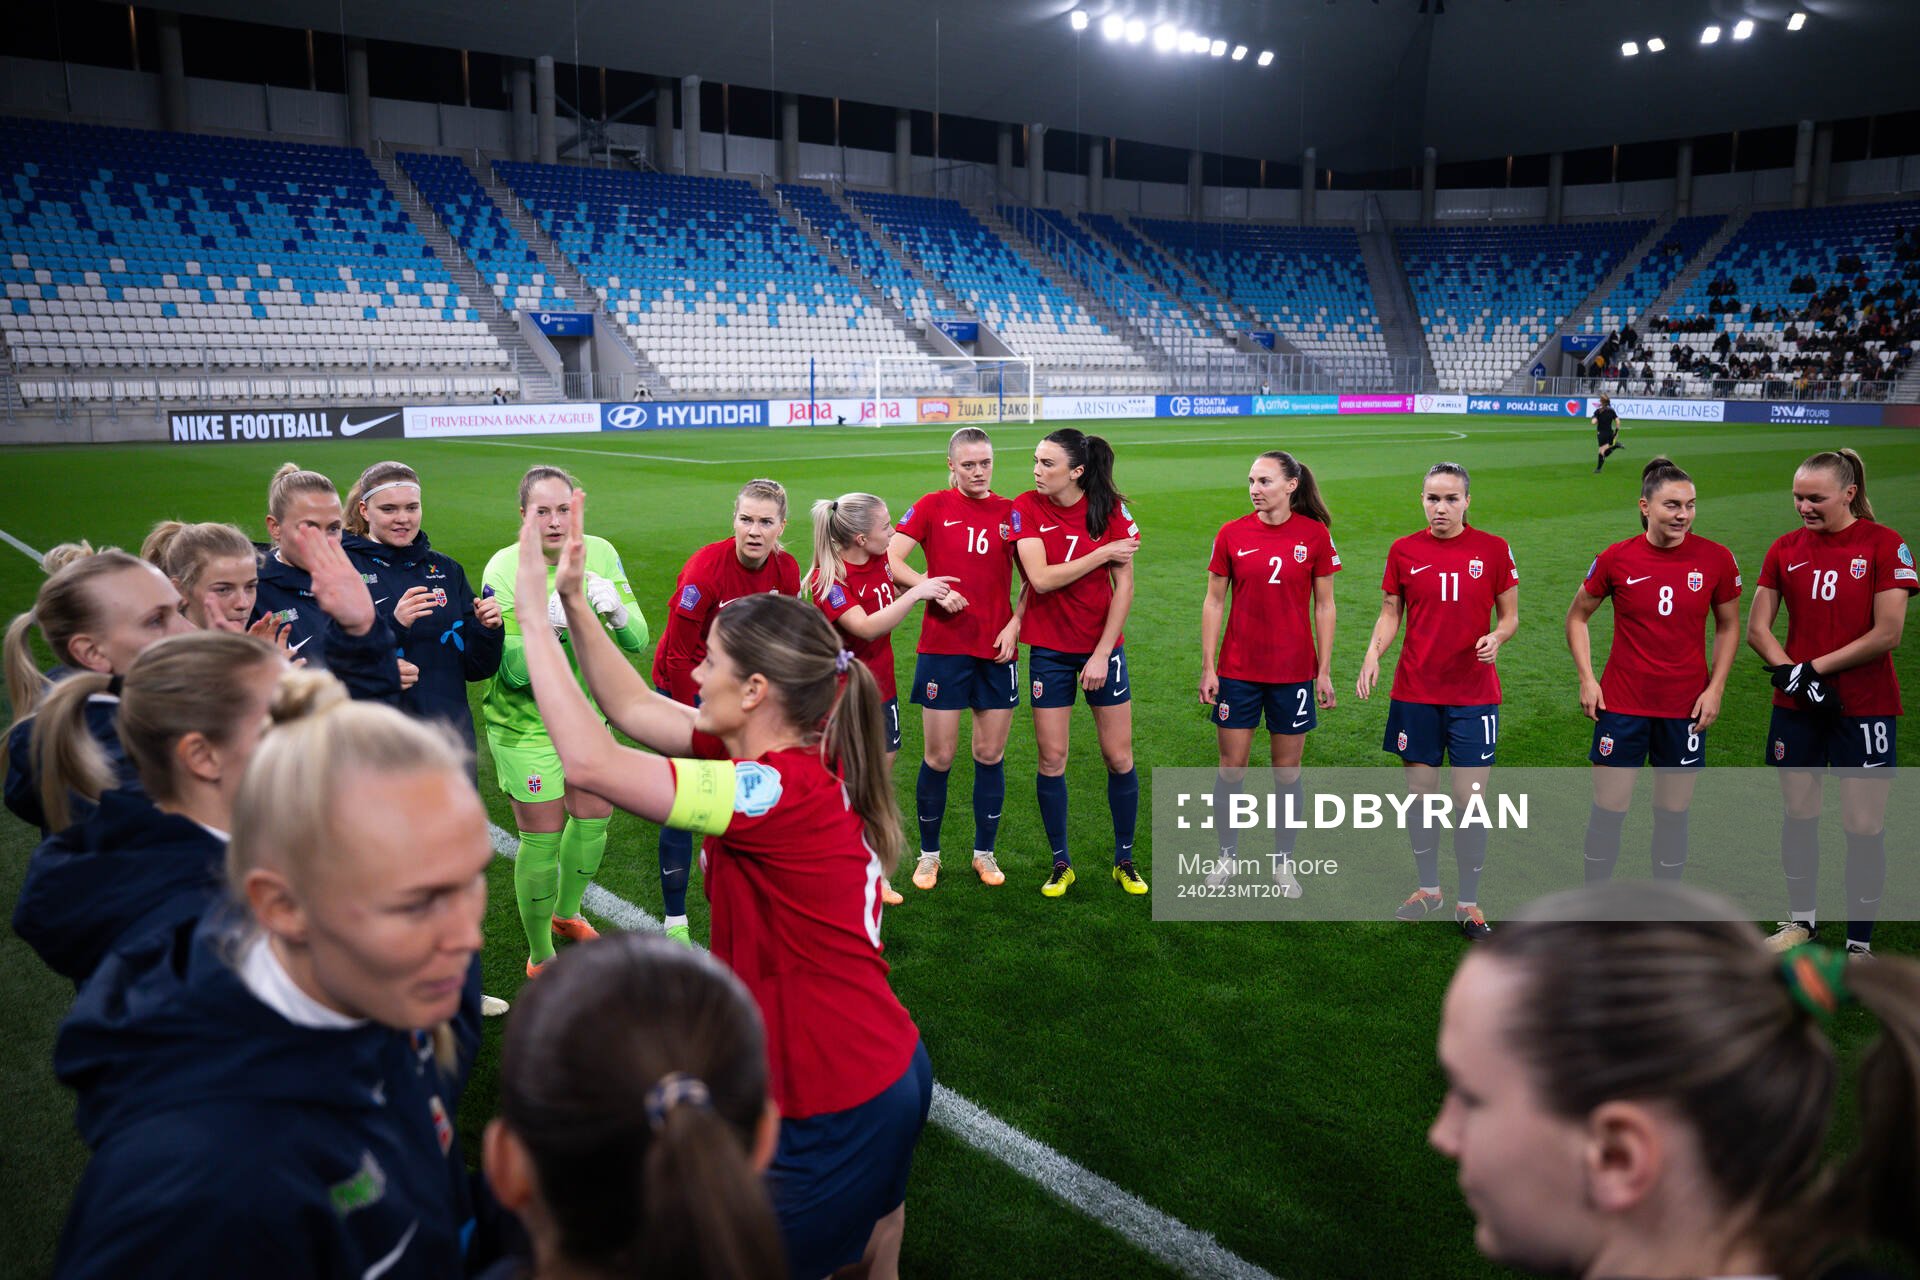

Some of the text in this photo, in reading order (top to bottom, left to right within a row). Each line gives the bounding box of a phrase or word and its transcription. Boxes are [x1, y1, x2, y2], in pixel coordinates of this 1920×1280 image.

[657, 404, 761, 426] HYUNDAI
[787, 401, 833, 424] jana
[958, 400, 984, 416] ŽUJA
[987, 403, 997, 416] JE
[1074, 401, 1127, 415] ARISTOS
[1193, 397, 1227, 406] CROATIA
[1193, 405, 1239, 415] OSIGURANJE
[1469, 400, 1559, 412] PSK POKAŽI SRCE
[1610, 403, 1720, 418] ROATIA AIRLINES
[1806, 408, 1830, 418] TOURS
[172, 413, 333, 441] NIKE FOOTBALL
[431, 412, 595, 427] PRIVREDNA BANKA ZAGREB
[967, 526, 989, 555] 16
[1064, 535, 1079, 562] 7
[1268, 556, 1283, 584] 2
[873, 583, 894, 609] 13
[1438, 572, 1459, 602] 11
[1811, 569, 1838, 601] 18
[1658, 585, 1674, 616] 8
[1008, 661, 1019, 690] 1
[1111, 654, 1122, 683] 7
[890, 701, 900, 731] 1
[1296, 688, 1308, 716] 2
[1481, 714, 1496, 745] 11
[1687, 722, 1700, 752] 8
[1860, 721, 1889, 755] 18
